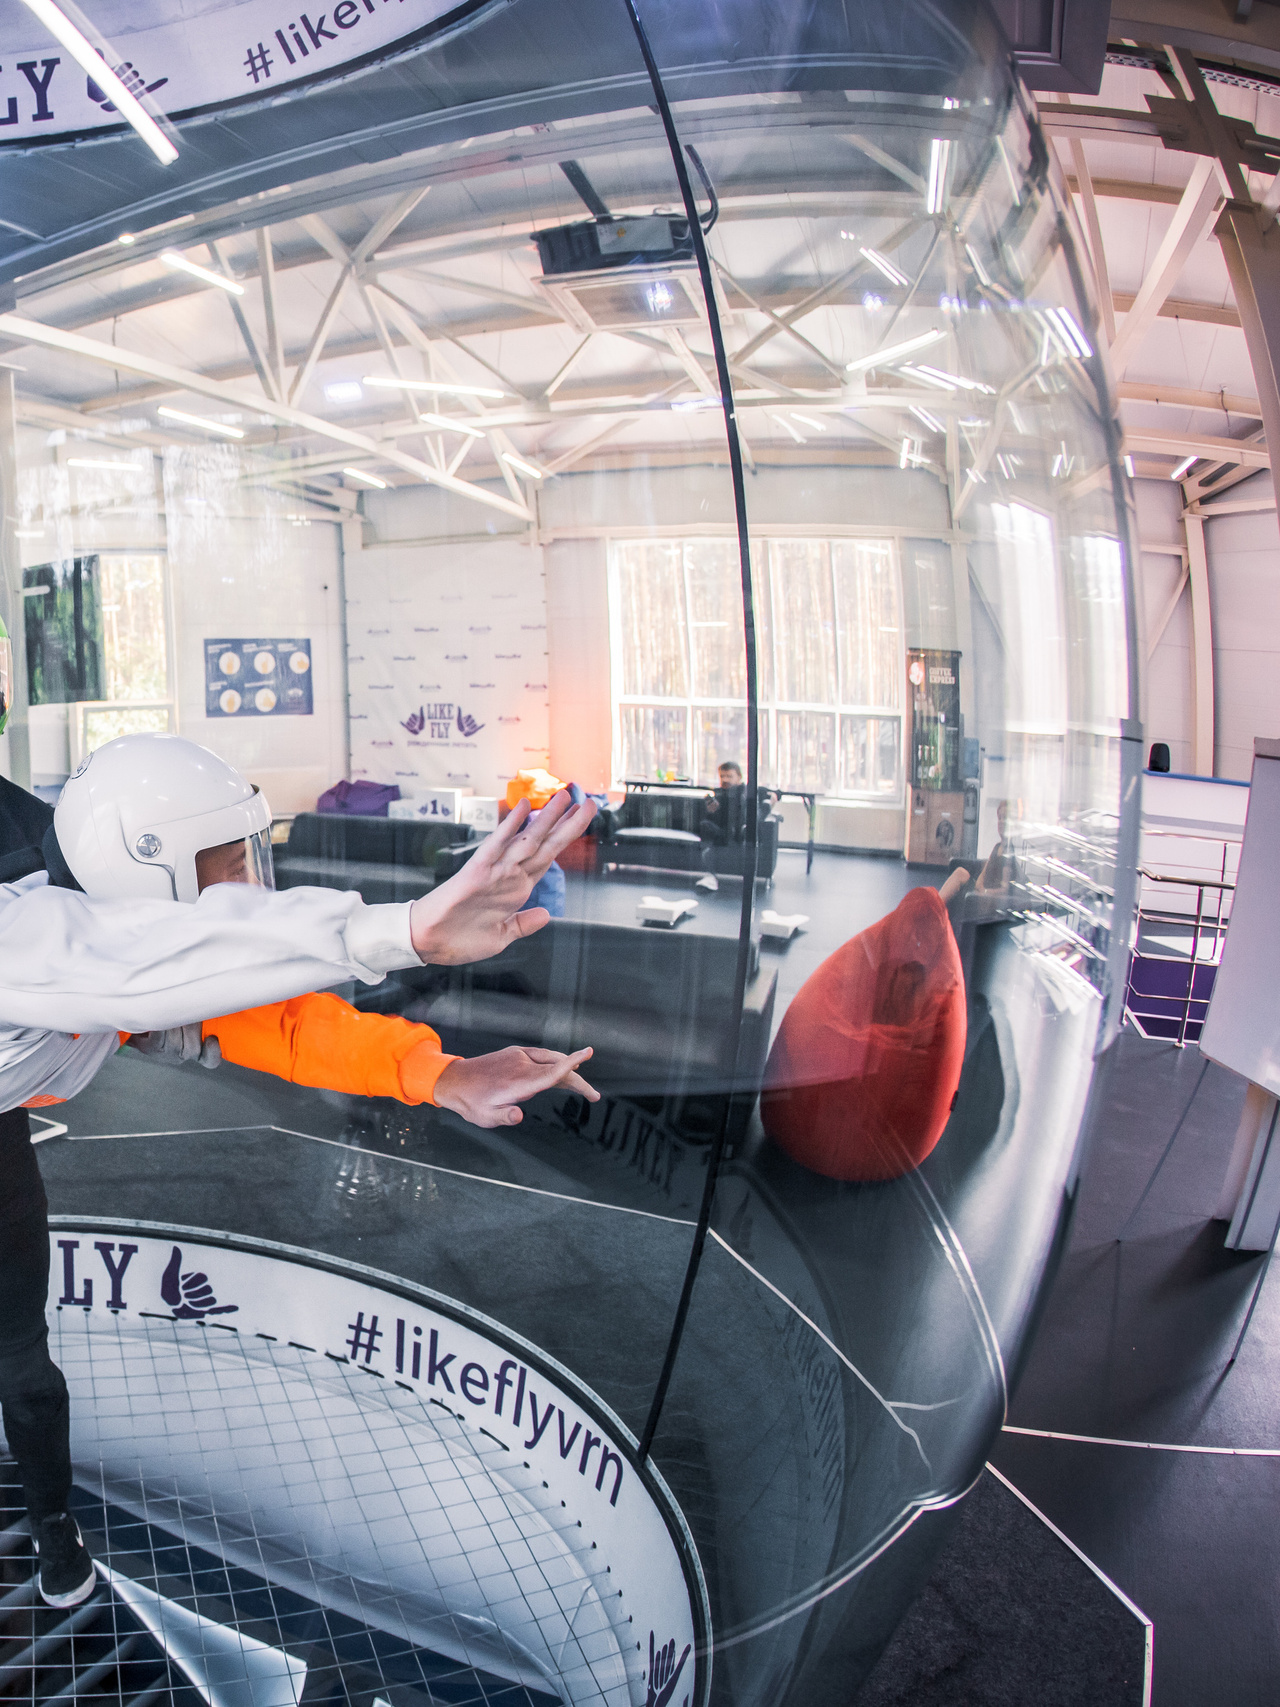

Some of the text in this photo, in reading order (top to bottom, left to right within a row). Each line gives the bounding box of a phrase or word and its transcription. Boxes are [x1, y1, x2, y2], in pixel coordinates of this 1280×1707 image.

[243, 0, 404, 84] #like
[427, 703, 454, 720] LIKE
[430, 722, 451, 739] FLY
[430, 799, 439, 815] 1
[345, 1311, 625, 1507] #likeflyvrn
